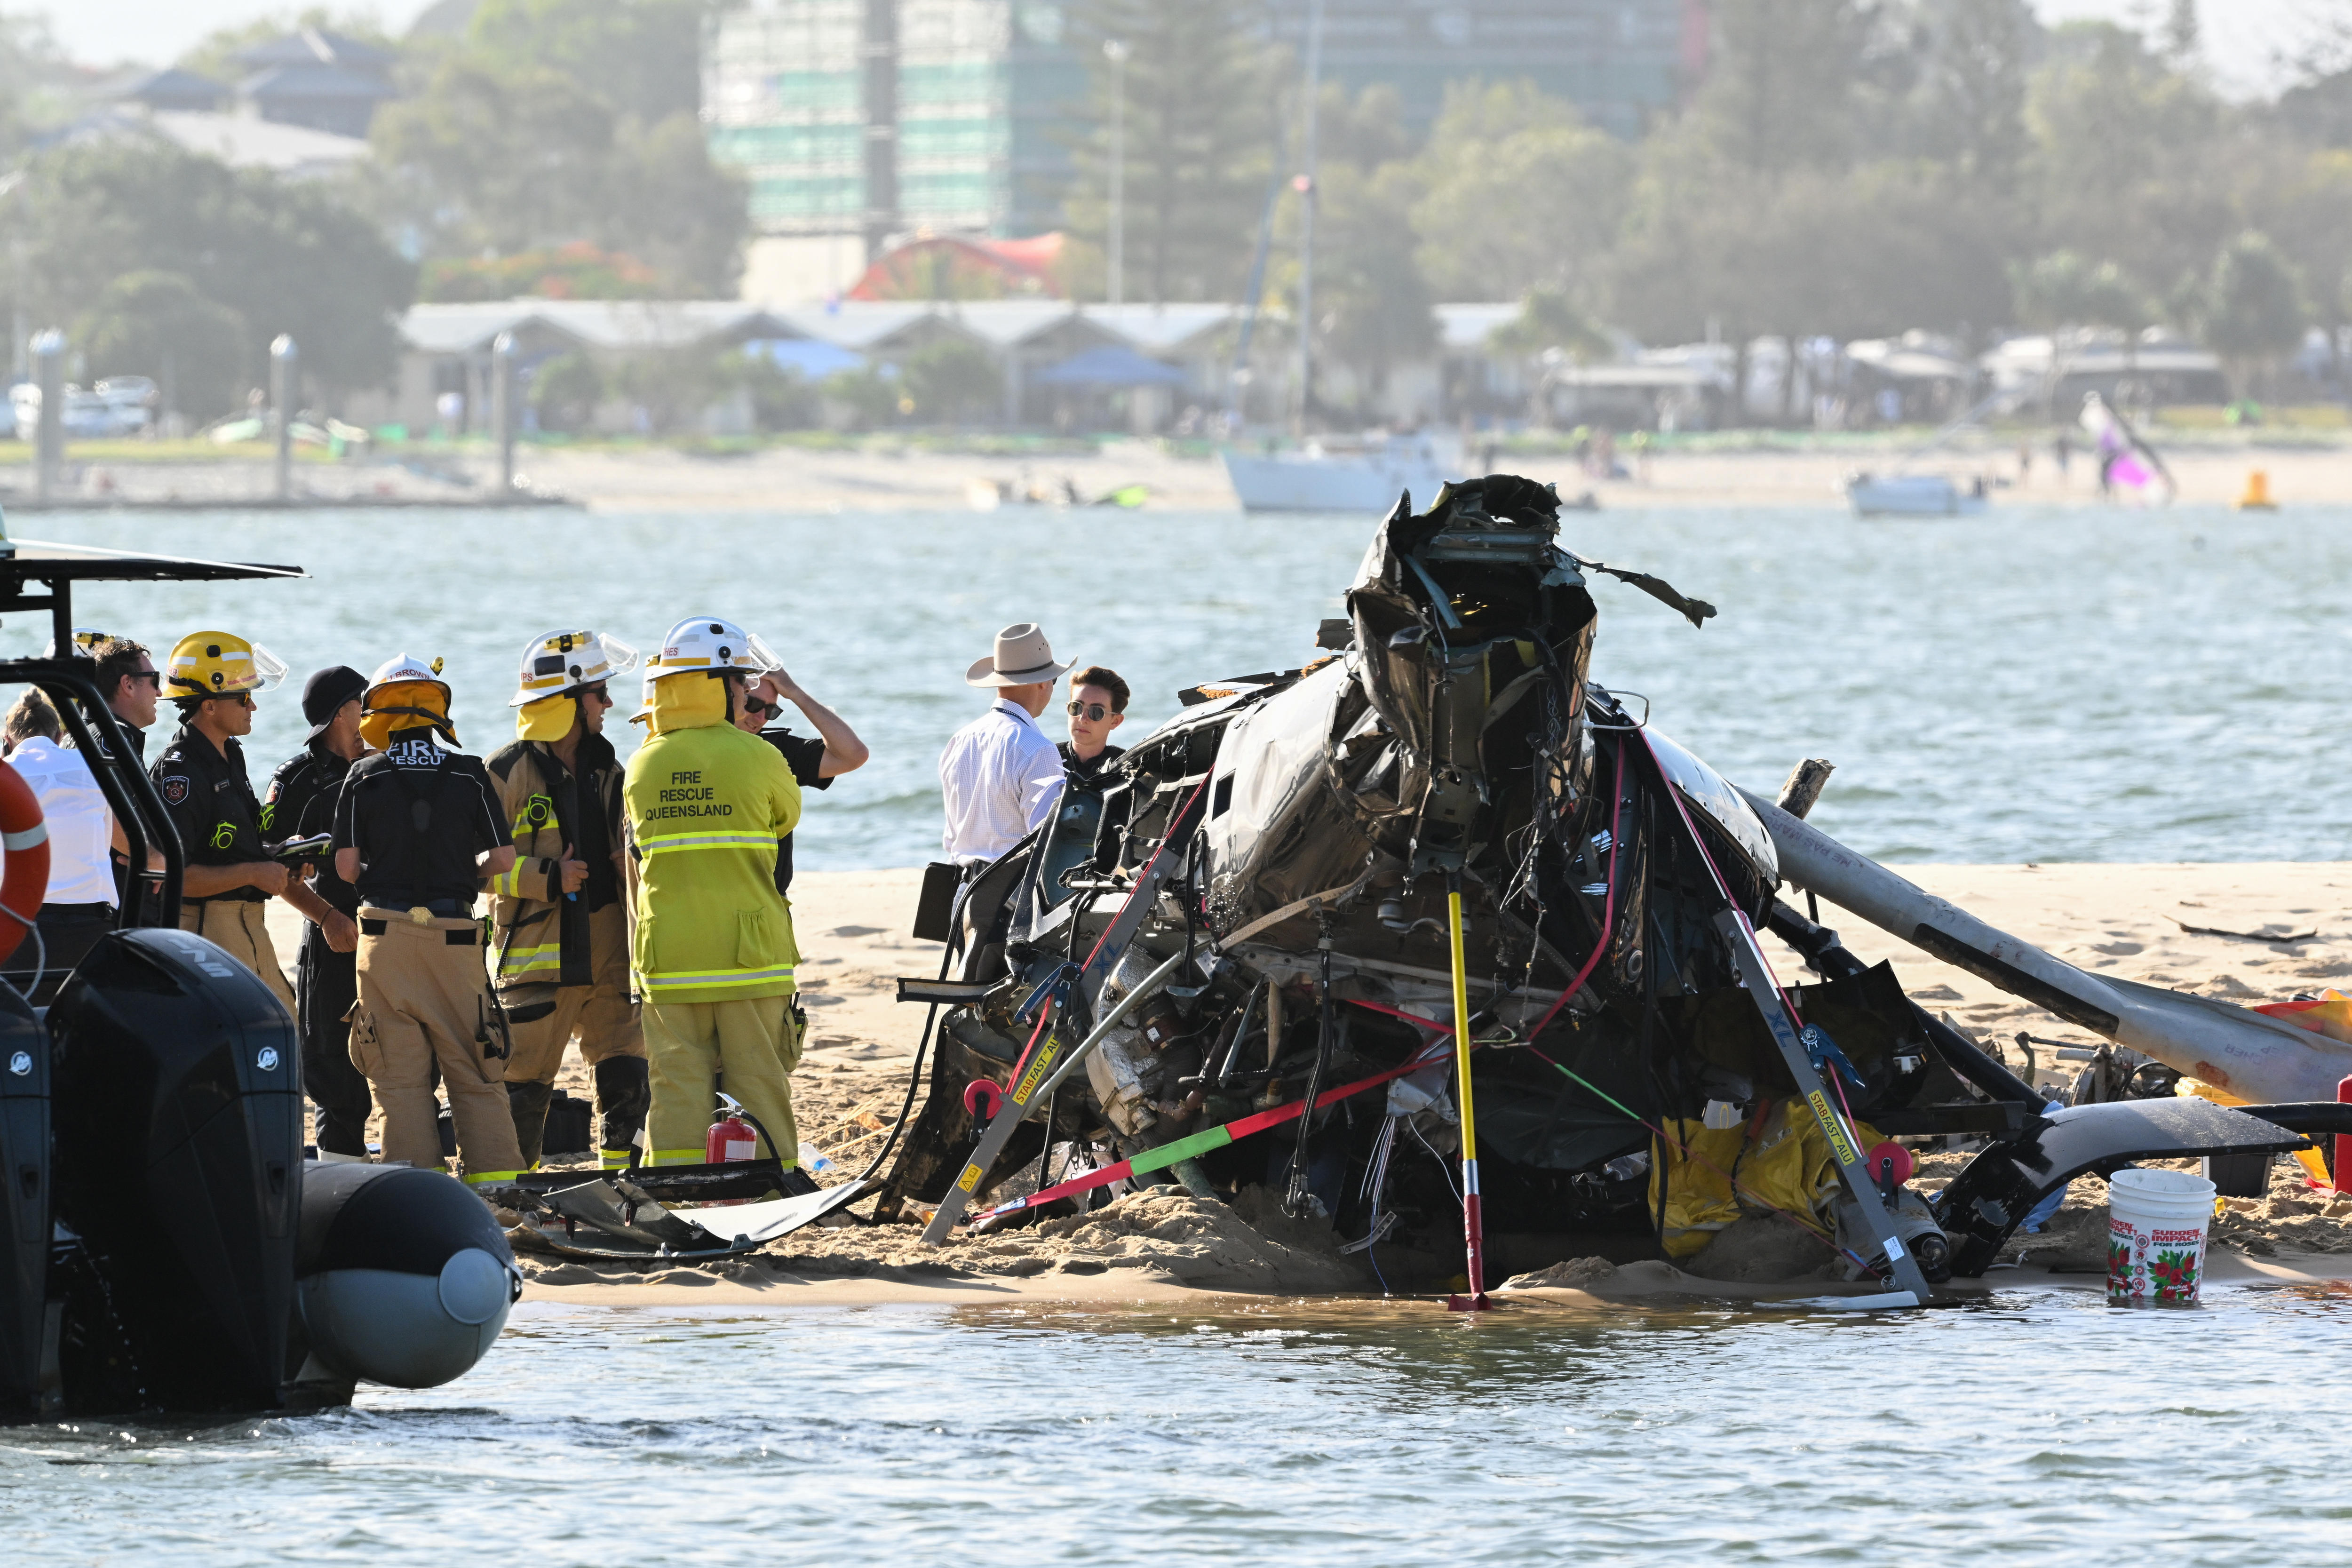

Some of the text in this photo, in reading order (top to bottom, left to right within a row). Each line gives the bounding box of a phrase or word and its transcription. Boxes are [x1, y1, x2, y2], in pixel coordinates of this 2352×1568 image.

[386, 740, 446, 757] FIRE
[672, 771, 701, 785] FIRE
[660, 788, 714, 803] RESCUE
[645, 804, 732, 821] QUEENSLAND
[1092, 941, 1123, 980] XL
[1764, 1010, 1794, 1048] XL
[1836, 1144, 1852, 1162] ALU
[2110, 1222, 2137, 1235] PACT!
[2111, 1218, 2133, 1229] DDEN
[2114, 1231, 2134, 1240] ROSES
[2152, 1233, 2202, 1242] IMPACT!
